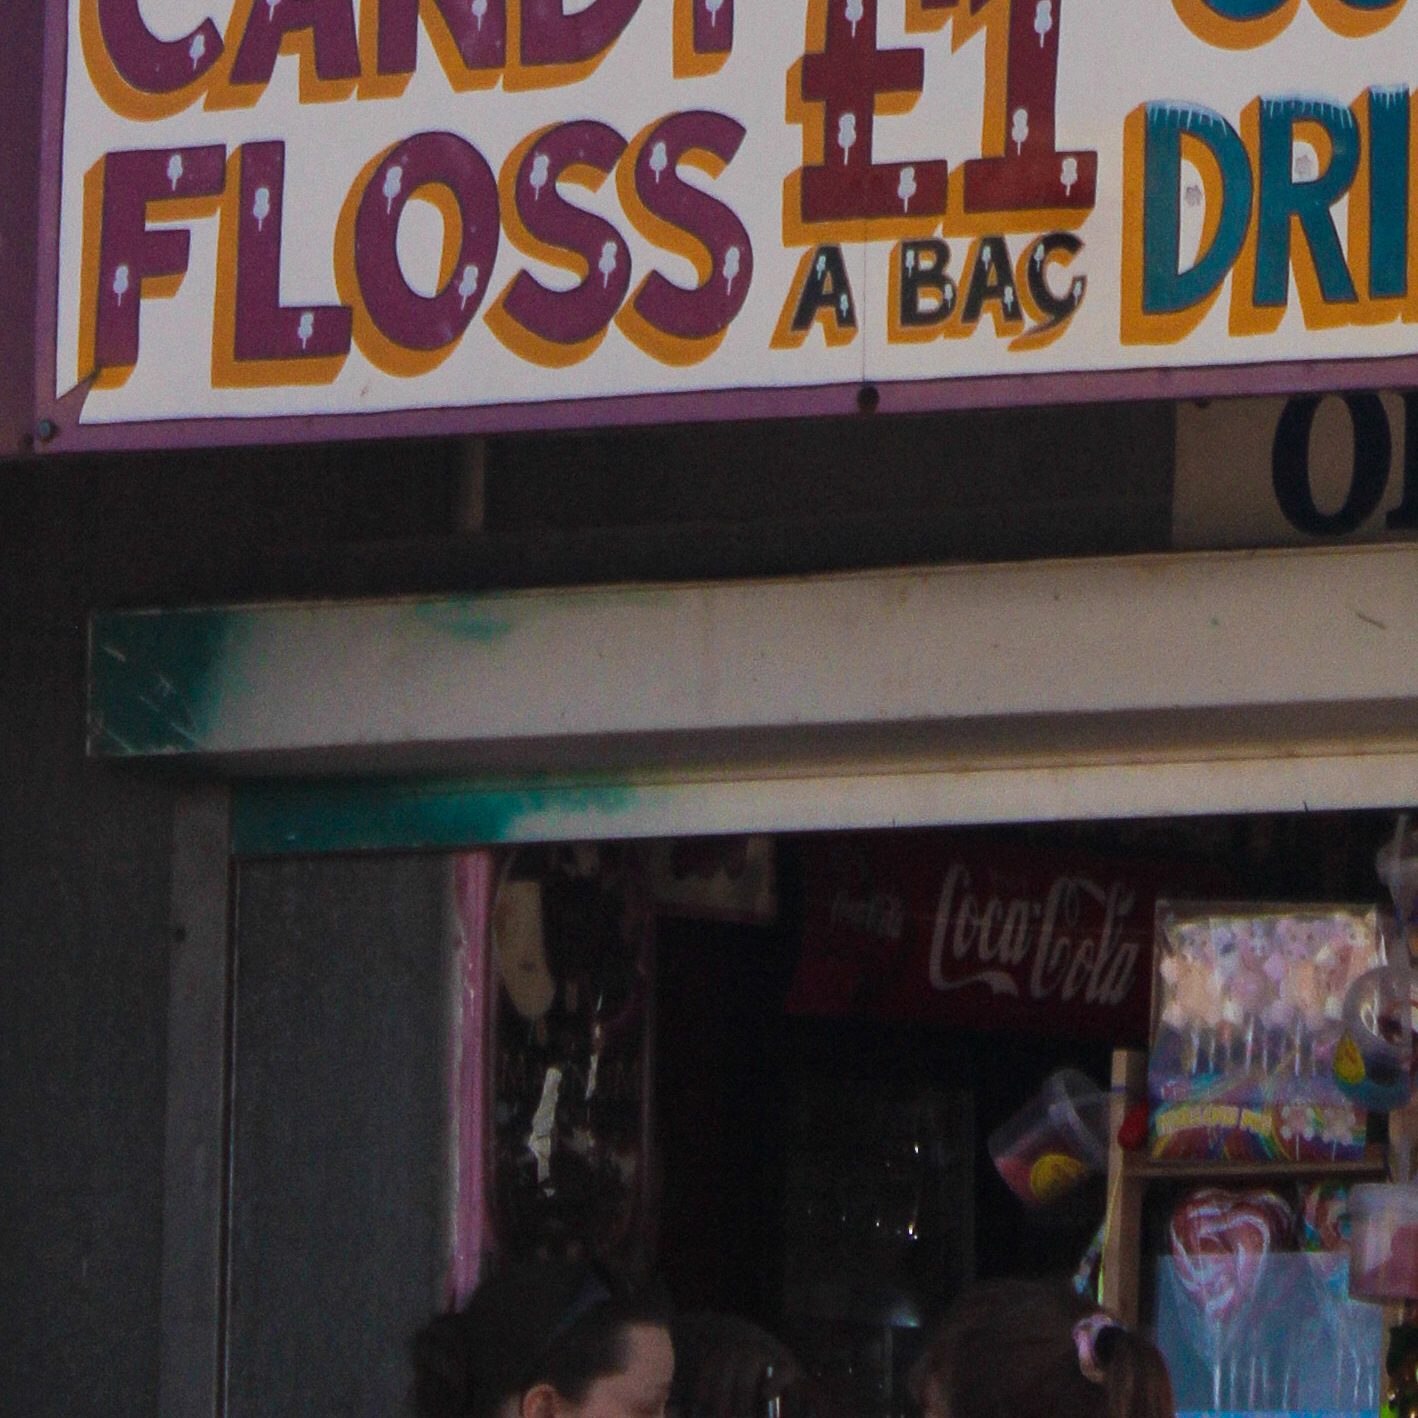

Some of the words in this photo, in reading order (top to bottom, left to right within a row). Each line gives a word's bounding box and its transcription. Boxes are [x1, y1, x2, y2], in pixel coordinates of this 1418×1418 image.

[82, 110, 753, 389] FLOSS
[769, 242, 858, 350] A
[888, 232, 1087, 352] BAG
